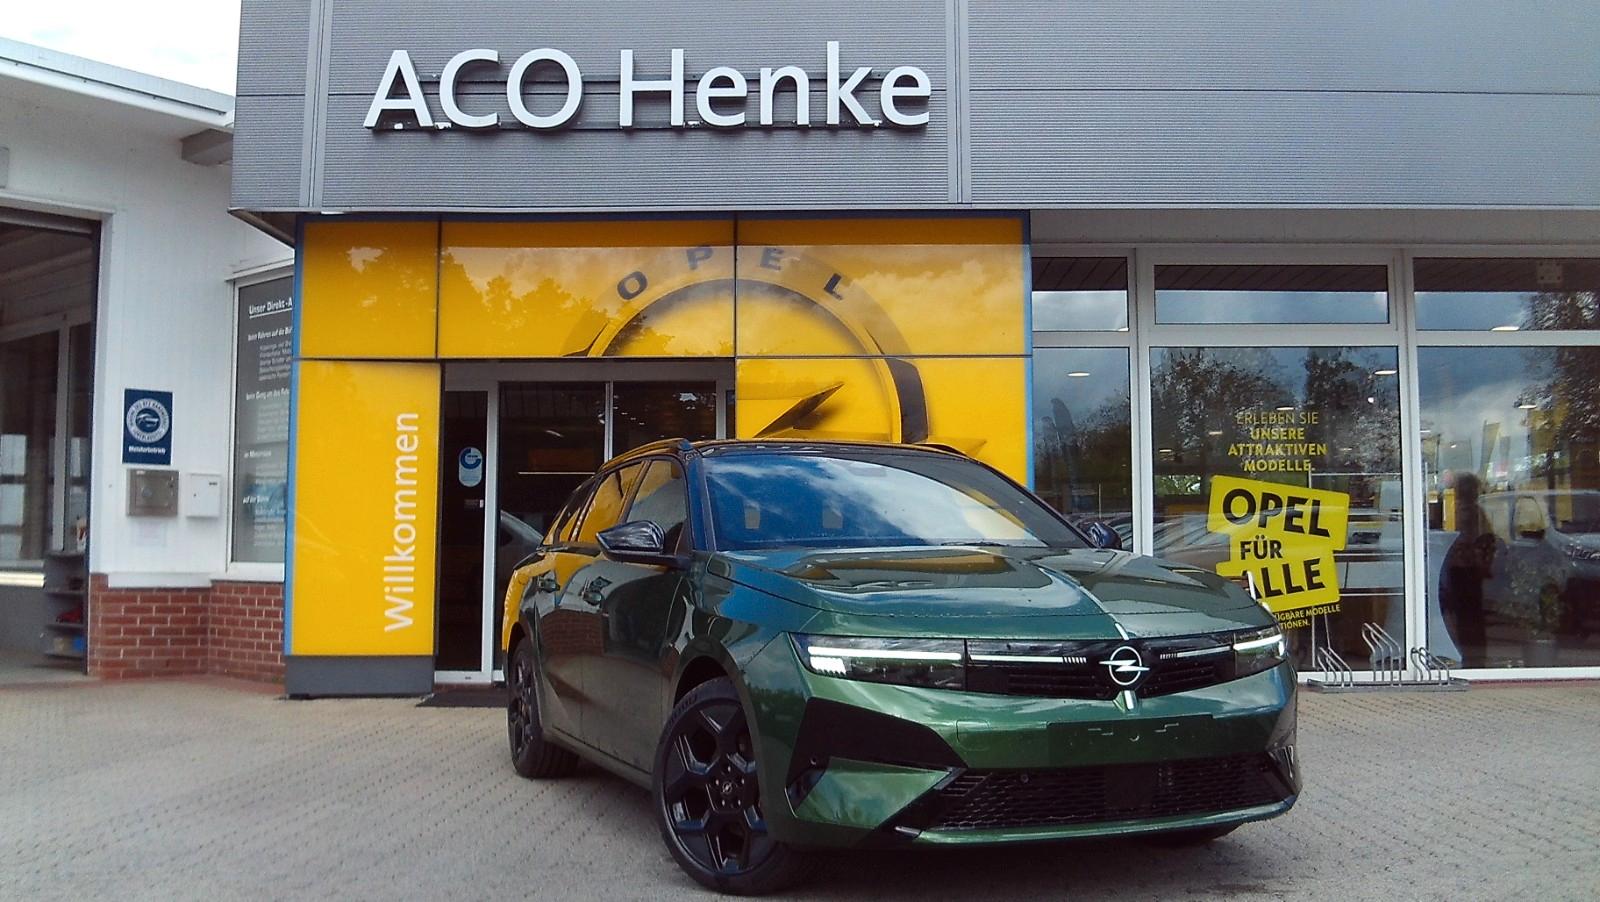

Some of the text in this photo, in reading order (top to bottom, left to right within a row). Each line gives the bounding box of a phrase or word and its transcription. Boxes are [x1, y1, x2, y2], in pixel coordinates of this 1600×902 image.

[363, 41, 931, 129] ACO Henke
[616, 246, 843, 301] OPEL
[1236, 411, 1319, 425] ERLEBEN SIE
[1251, 427, 1305, 440] UNSERE
[1228, 444, 1328, 456] ATTRAKTIVEN
[1243, 459, 1316, 472] MODELLE.
[383, 412, 419, 632] Willkommen
[1222, 488, 1331, 538] OPEL
[1240, 534, 1283, 560] FÜR
[1305, 604, 1341, 617] MODELLE
